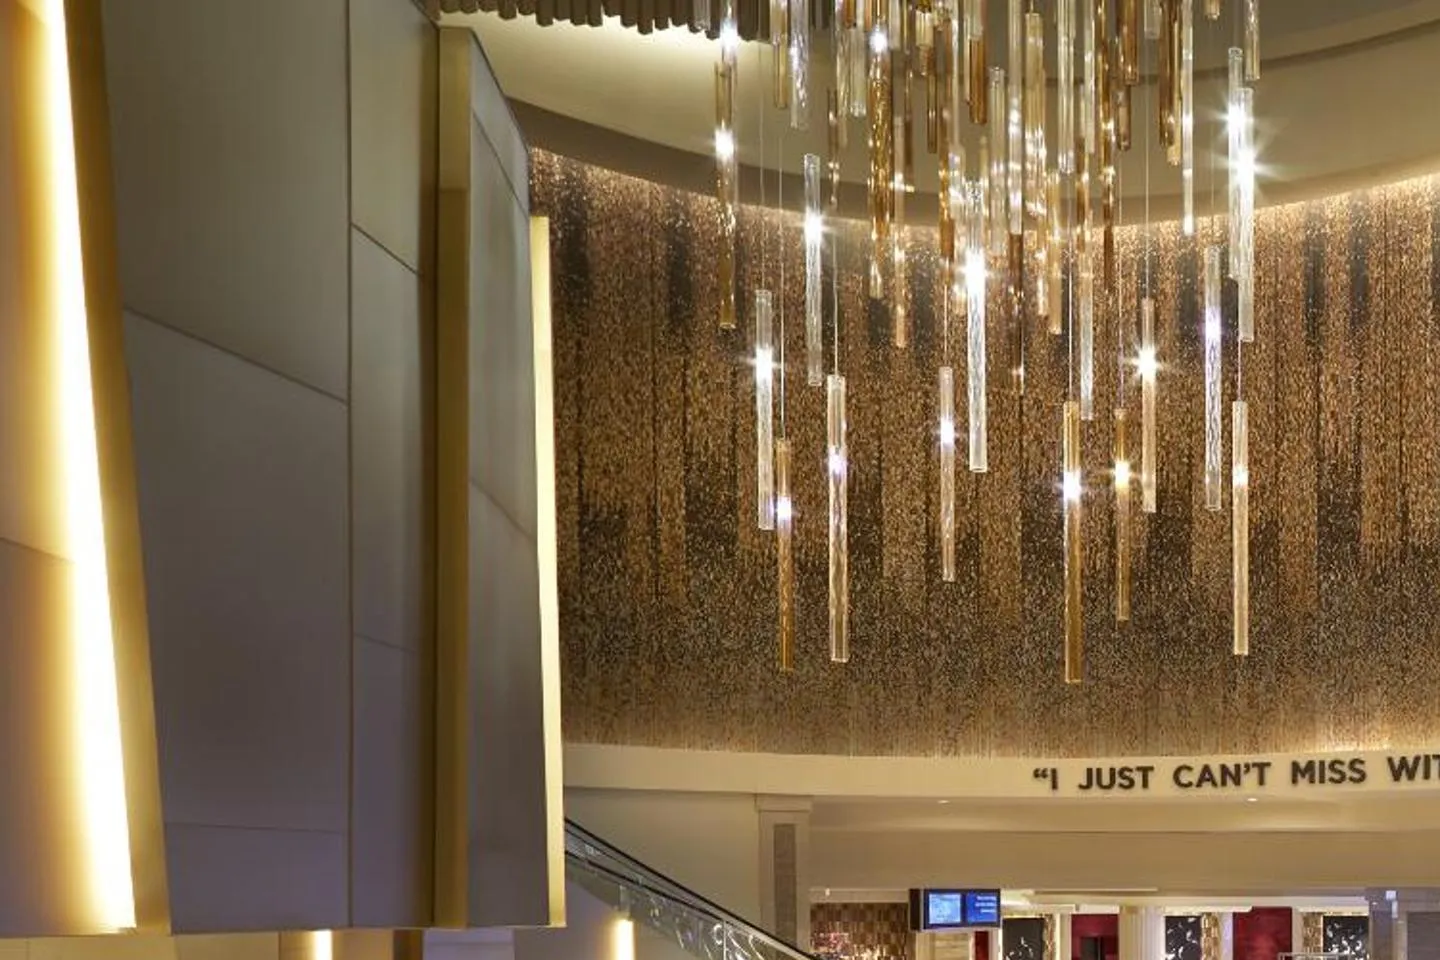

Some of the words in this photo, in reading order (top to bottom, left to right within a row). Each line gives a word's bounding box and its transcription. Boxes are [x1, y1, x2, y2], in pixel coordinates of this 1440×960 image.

[1078, 765, 1155, 791] JUST
[1172, 761, 1272, 789] CAN’T
[1291, 758, 1367, 785] MISS
